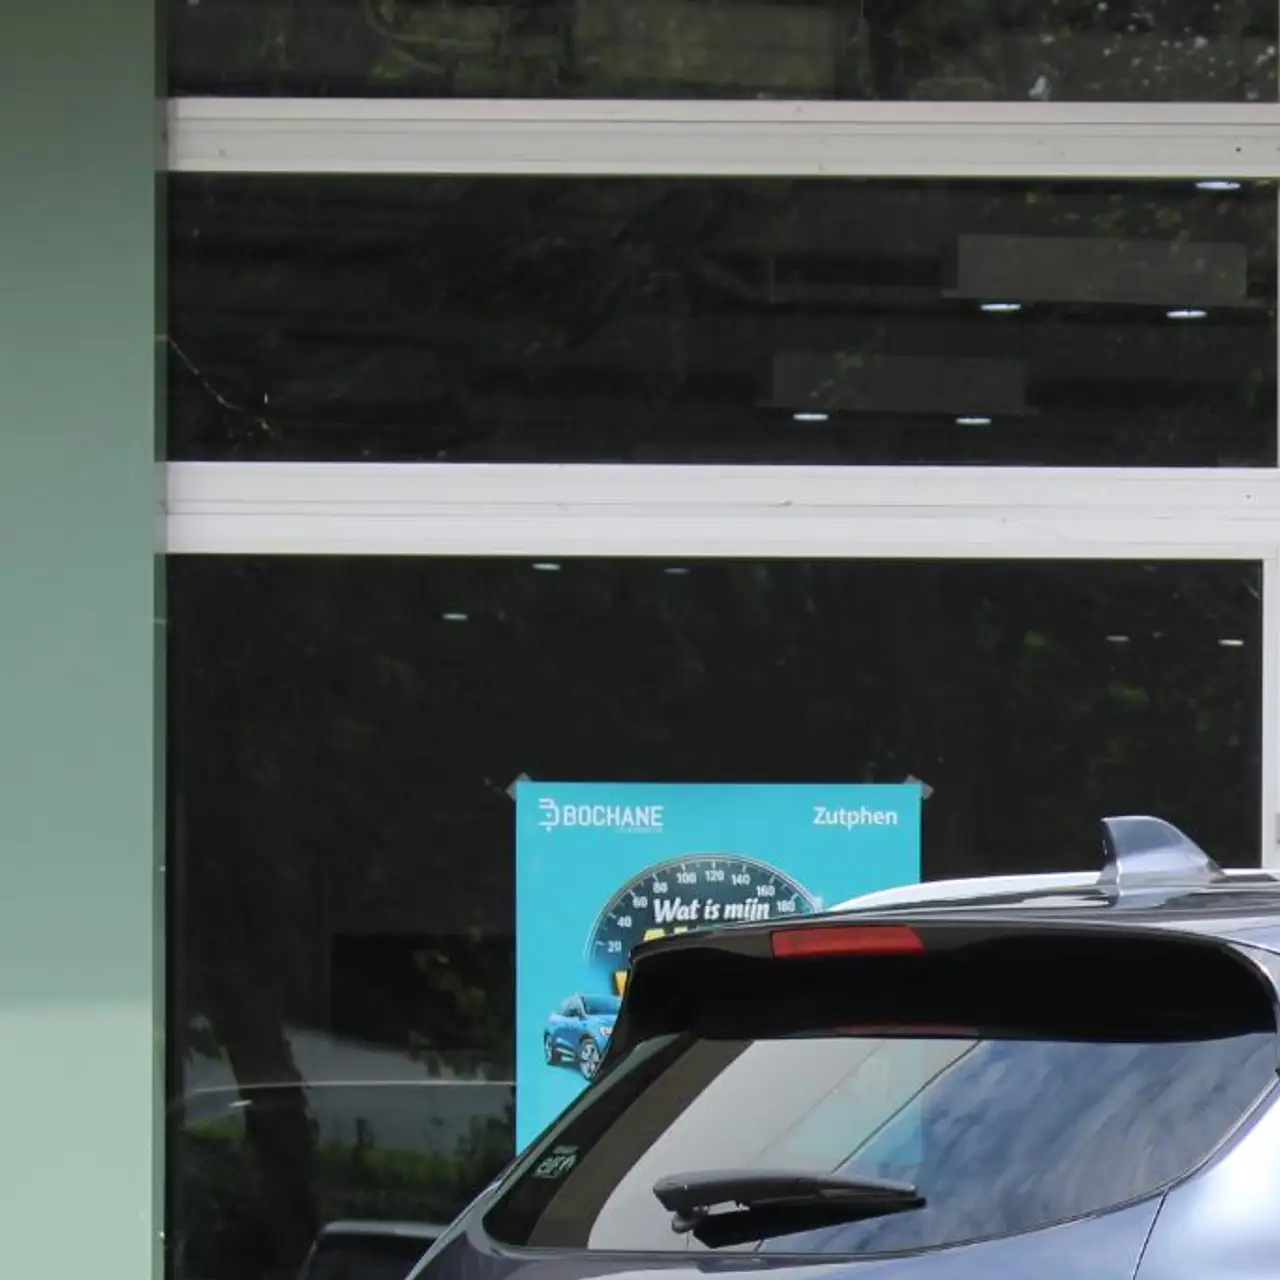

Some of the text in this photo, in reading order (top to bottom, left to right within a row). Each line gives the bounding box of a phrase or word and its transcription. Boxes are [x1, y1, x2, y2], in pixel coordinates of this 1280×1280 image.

[563, 804, 664, 827] BOCHANE
[812, 806, 899, 831] Zutphen
[676, 872, 697, 885] 100
[704, 870, 725, 882] 120
[731, 873, 751, 886] 140
[653, 897, 770, 923] Wat is mijn
[617, 916, 633, 928] 40
